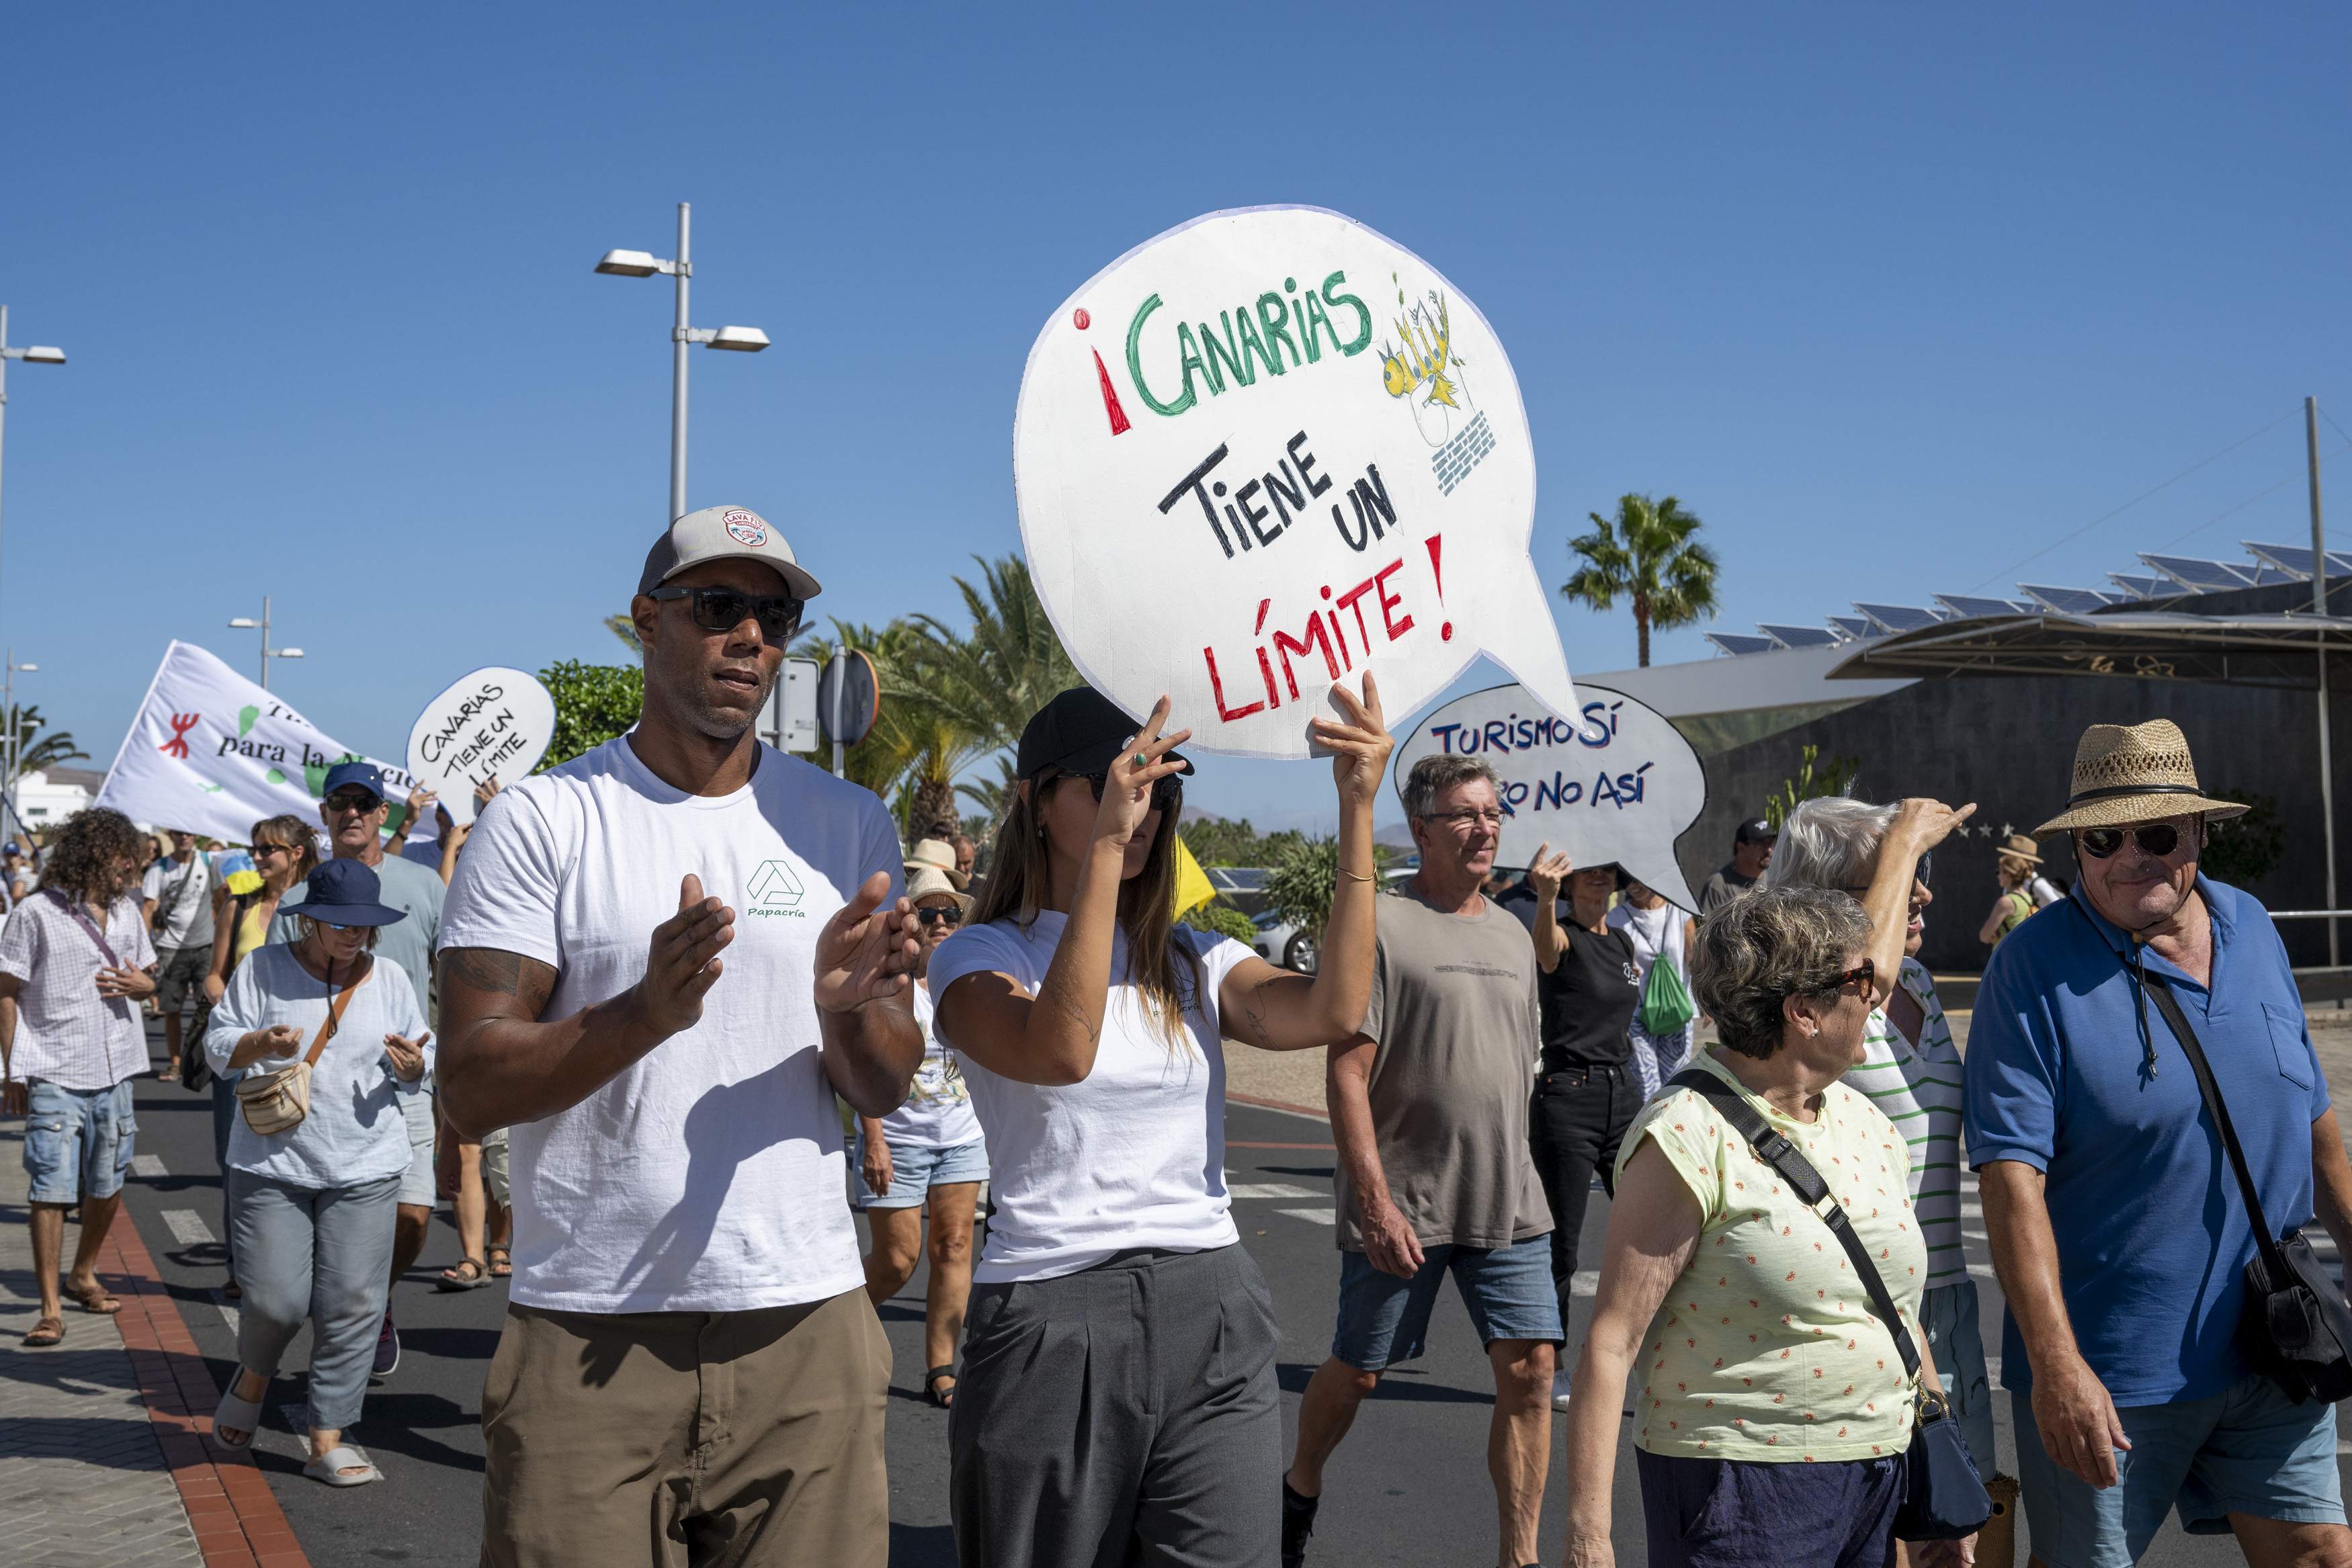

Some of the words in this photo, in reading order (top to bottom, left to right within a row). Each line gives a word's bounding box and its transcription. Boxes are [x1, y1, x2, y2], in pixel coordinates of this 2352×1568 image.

[1332, 463, 1398, 552] UN
[491, 707, 514, 733] UN
[1577, 700, 1624, 750] SÍ
[217, 736, 285, 763] para
[300, 743, 324, 769] la
[1590, 761, 1654, 810] ASÍ
[748, 908, 806, 918] Papacría
